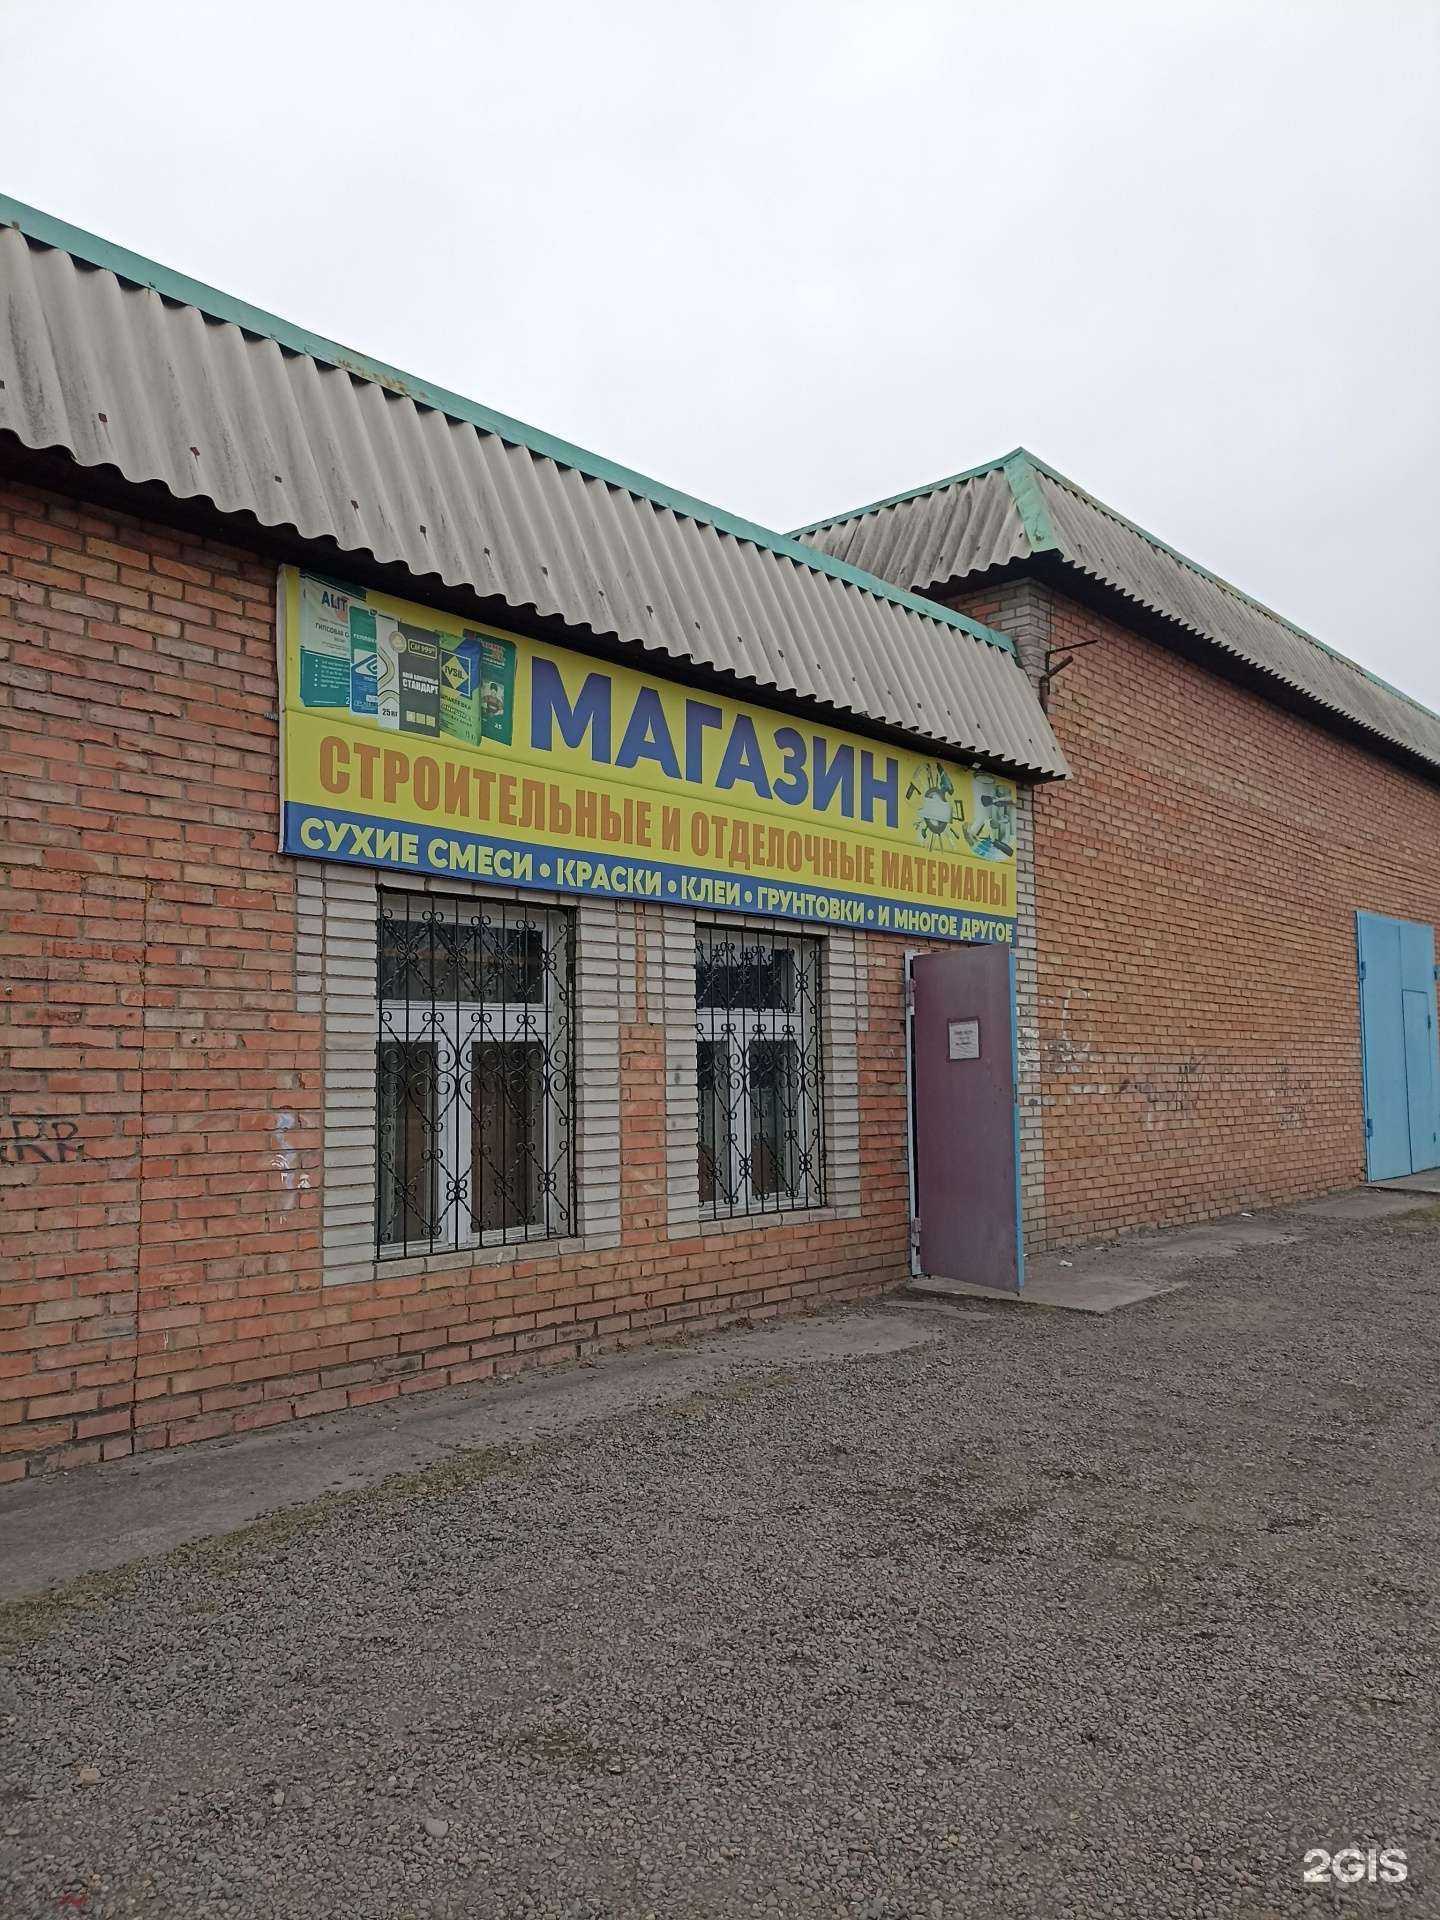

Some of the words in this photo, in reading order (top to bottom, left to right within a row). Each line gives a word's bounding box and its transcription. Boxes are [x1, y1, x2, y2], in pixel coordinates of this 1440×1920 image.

[320, 736, 651, 848] СТРОИТЕЛЬНЫЕ
[662, 805, 681, 853] И
[691, 811, 875, 885] ОТДЕЛОЧНЫЕ
[881, 850, 1008, 907] МАТЕРИАЛЫ
[531, 656, 898, 829] МАГАЗИН
[300, 817, 419, 864] СУХИЕ
[428, 838, 533, 881] СМЕСИ
[556, 858, 662, 897] КРАСКИ
[757, 886, 865, 924] ГРУНТОВКИ
[878, 904, 889, 926] И
[894, 907, 957, 936] МНОГОЕ
[960, 917, 1013, 943] ДРУГОЕ
